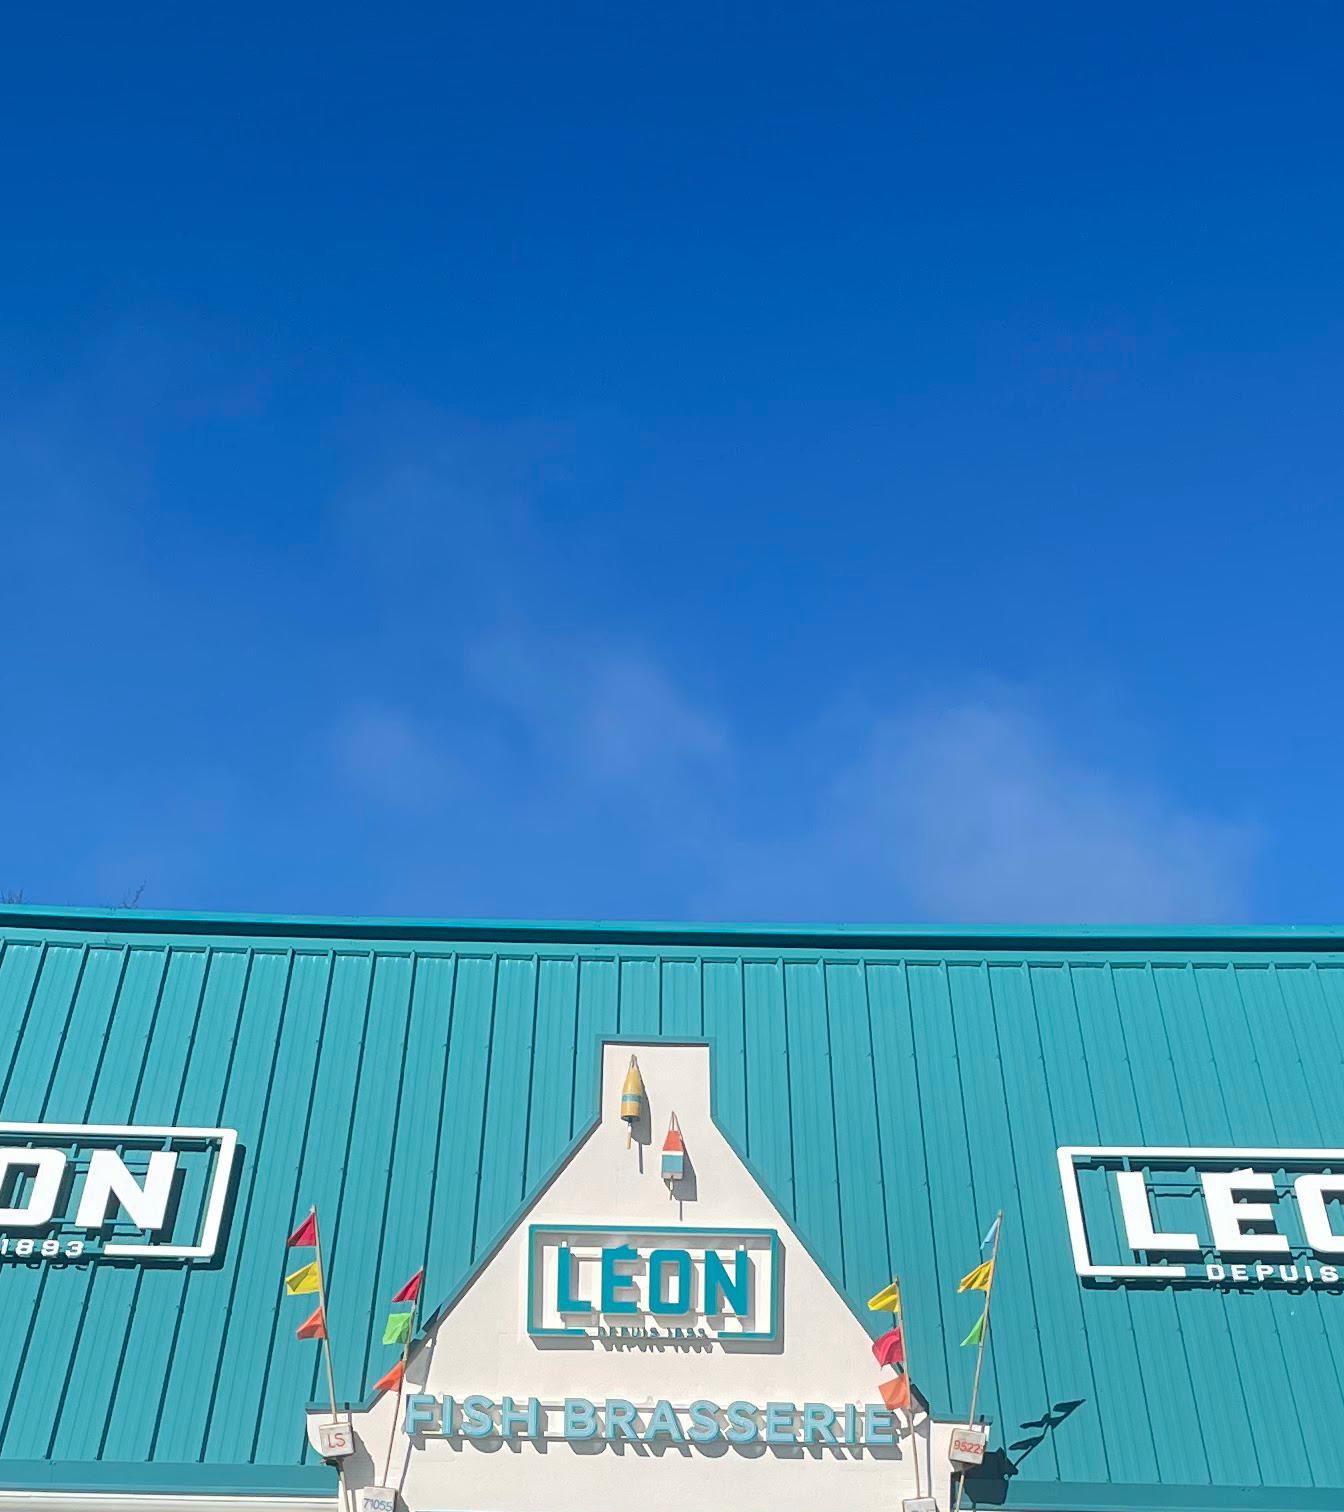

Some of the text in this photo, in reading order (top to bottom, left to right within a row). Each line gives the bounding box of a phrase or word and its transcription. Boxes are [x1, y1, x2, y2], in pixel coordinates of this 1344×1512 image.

[0, 1238, 85, 1258] 1893
[557, 1243, 748, 1316] LÉON
[1205, 1264, 1340, 1283] DEPUIS
[405, 1394, 899, 1446] FISH BRASSERIE
